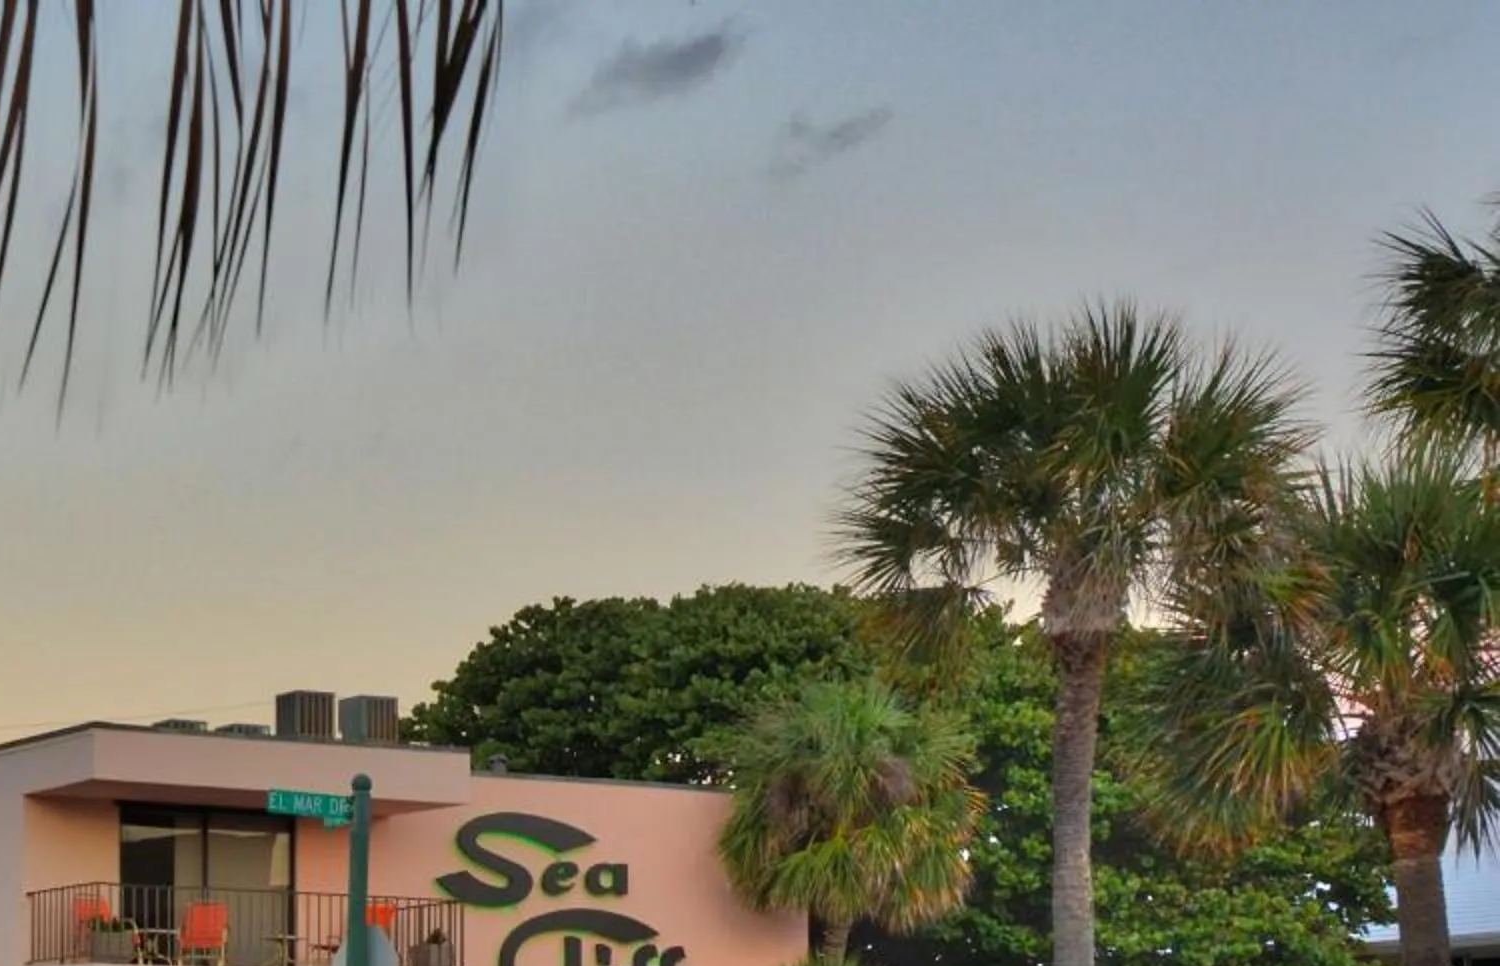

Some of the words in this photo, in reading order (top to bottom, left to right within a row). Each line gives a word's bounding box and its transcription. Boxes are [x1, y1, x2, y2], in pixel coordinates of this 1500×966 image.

[268, 791, 287, 812] EL
[293, 795, 323, 814] MAR
[435, 812, 628, 908] Sea
